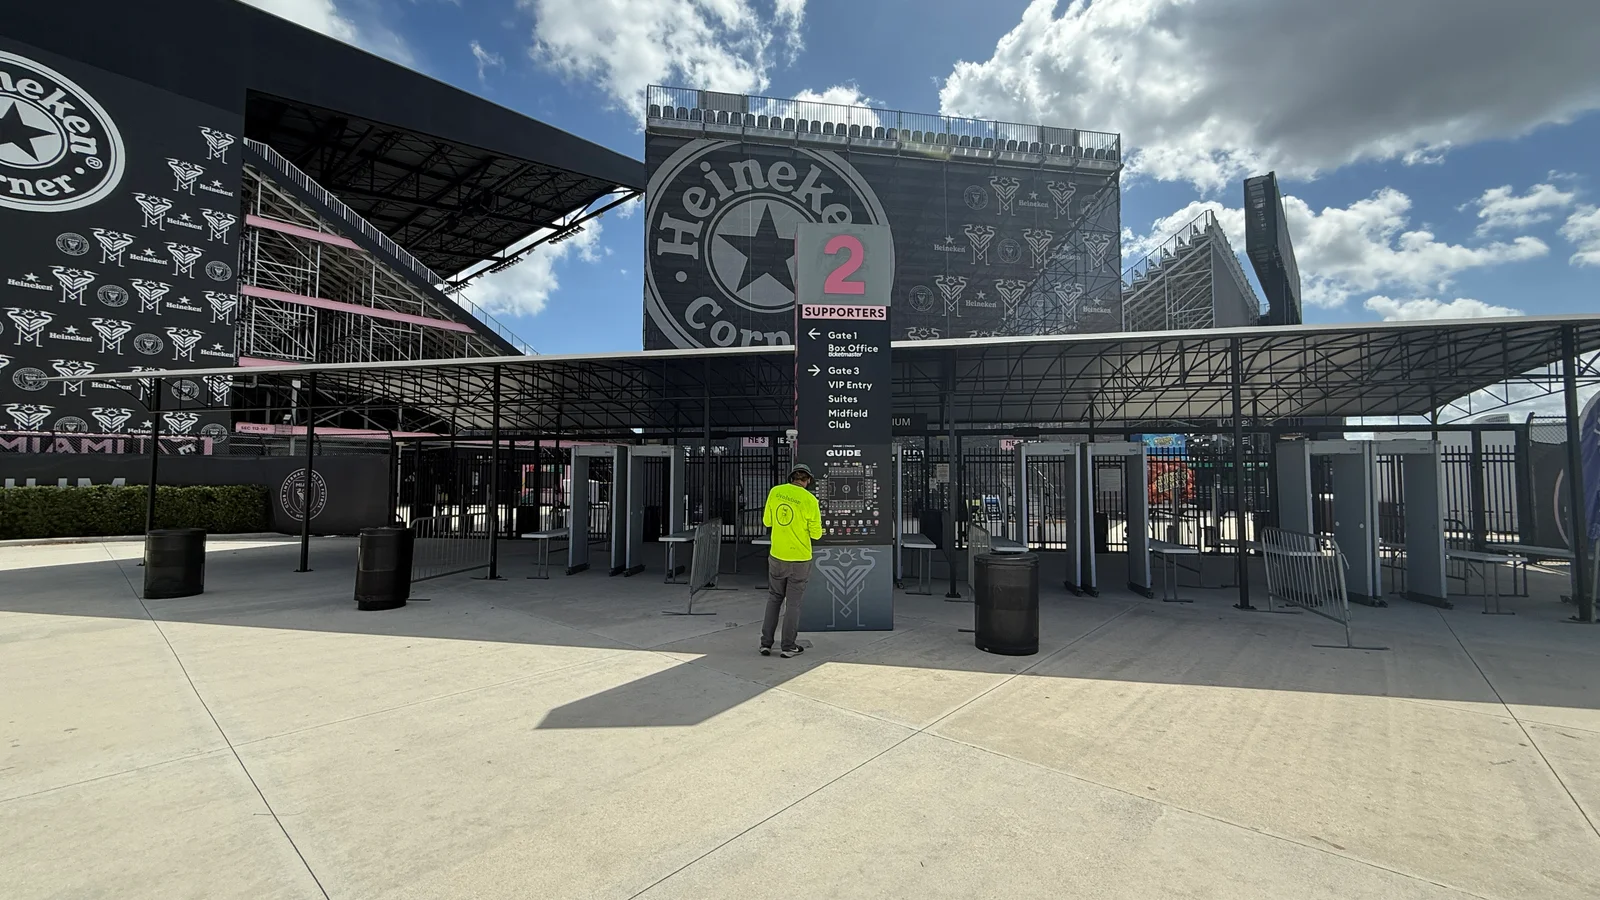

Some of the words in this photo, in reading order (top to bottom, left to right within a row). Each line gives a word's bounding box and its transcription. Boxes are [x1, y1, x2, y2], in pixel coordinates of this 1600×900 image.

[200, 184, 233, 196] Heineken
[1019, 200, 1049, 208] Heineken
[657, 159, 853, 260] Heineke
[167, 218, 202, 230] Heineken
[934, 244, 965, 253] Heineken
[130, 253, 168, 265] Heineken
[824, 234, 865, 294] 2
[8, 278, 53, 291] Heineken
[166, 302, 202, 313] Heineken
[966, 300, 997, 308] Heineken
[804, 307, 885, 318] SUPPORTERS
[1083, 306, 1111, 314] Heineken
[685, 297, 791, 347] Corn
[49, 332, 93, 343] Heineken
[828, 332, 852, 340] Gate
[854, 332, 858, 340] 1
[828, 344, 846, 352] Box
[848, 344, 879, 352] Office
[200, 349, 234, 358] Heineken
[828, 367, 852, 375] Gate
[854, 367, 860, 375] 3
[828, 381, 845, 389] VIP
[847, 381, 873, 391] Entry
[828, 395, 858, 403] Suites
[828, 409, 868, 418] Midfield
[828, 421, 851, 429] Club
[892, 417, 911, 426] IUM
